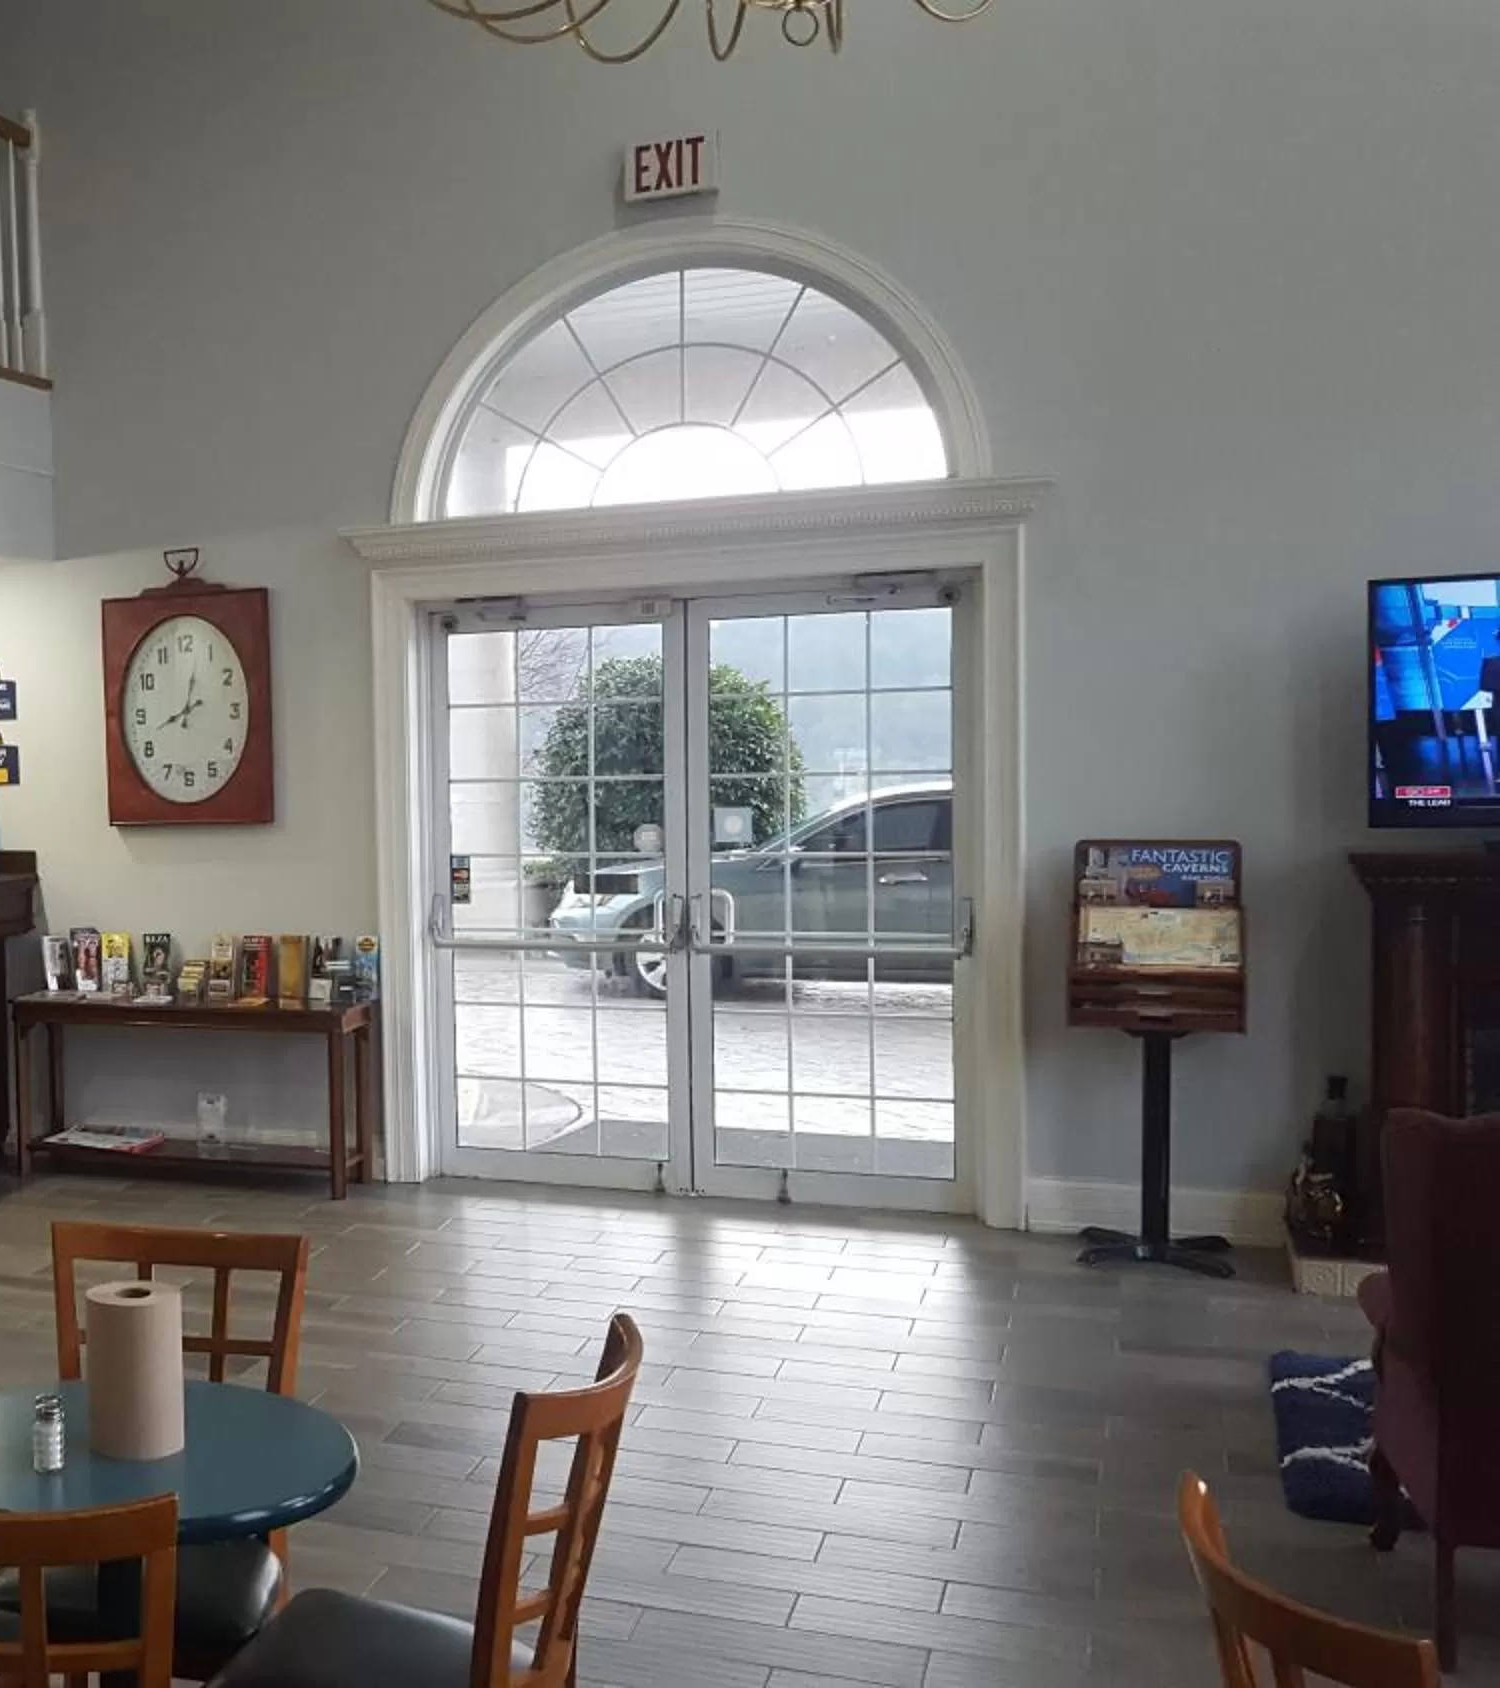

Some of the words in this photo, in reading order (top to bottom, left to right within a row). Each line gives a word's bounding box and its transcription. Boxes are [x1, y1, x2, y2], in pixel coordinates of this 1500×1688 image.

[634, 136, 705, 193] EXIT
[177, 635, 194, 652] 12
[157, 647, 169, 665] 11
[207, 644, 213, 663] 1
[140, 673, 155, 691] 10
[222, 668, 233, 687] 2
[135, 708, 147, 725] 9
[229, 703, 241, 720] 3
[144, 741, 154, 758] 8
[223, 738, 233, 754] 4
[163, 764, 173, 781] 7
[184, 771, 195, 786] 6
[207, 762, 217, 778] 5
[1131, 849, 1230, 863] FANTASTIC
[1162, 863, 1228, 873] CAVERNS
